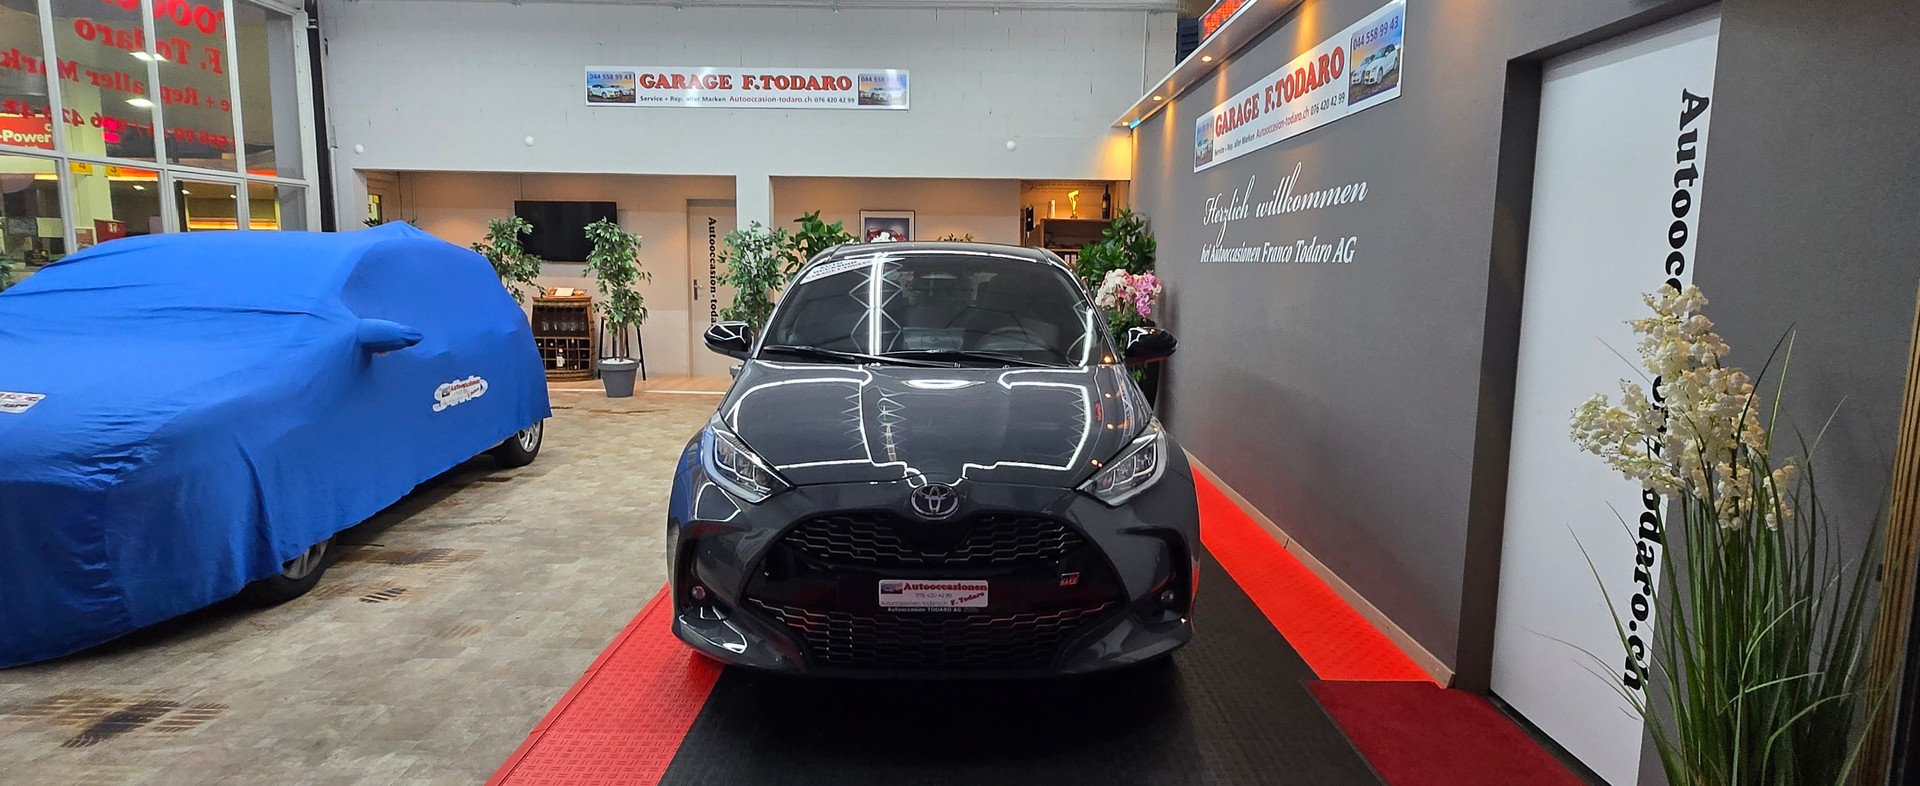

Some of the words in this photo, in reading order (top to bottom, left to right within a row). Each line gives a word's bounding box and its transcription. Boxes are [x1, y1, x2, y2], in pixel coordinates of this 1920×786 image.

[1352, 34, 1364, 50] 044
[1366, 27, 1378, 44] 558
[1380, 21, 1389, 37] 99
[1390, 15, 1399, 31] 43
[639, 73, 733, 90] GARAGE
[741, 74, 853, 91] F.TODARO
[1215, 92, 1260, 137] GARAGE
[1264, 45, 1345, 114] F.TODARO
[729, 95, 813, 103] Autooccasion-todaro.ch
[1310, 102, 1319, 116] 076
[1320, 98, 1330, 111] 420
[1330, 95, 1337, 106] 42
[1338, 91, 1346, 105] 99
[1203, 174, 1256, 246] Herzlich
[1255, 161, 1369, 218] willkommen
[1200, 243, 1211, 263] bei
[1209, 241, 1261, 263] Autooccasionen
[1261, 242, 1293, 263] Franco
[1294, 236, 1332, 263] Todaro
[1332, 236, 1358, 263] AG
[708, 216, 719, 326] Autooccasion-toda
[903, 583, 987, 591] Autooccasionen
[959, 591, 985, 603] Todaro
